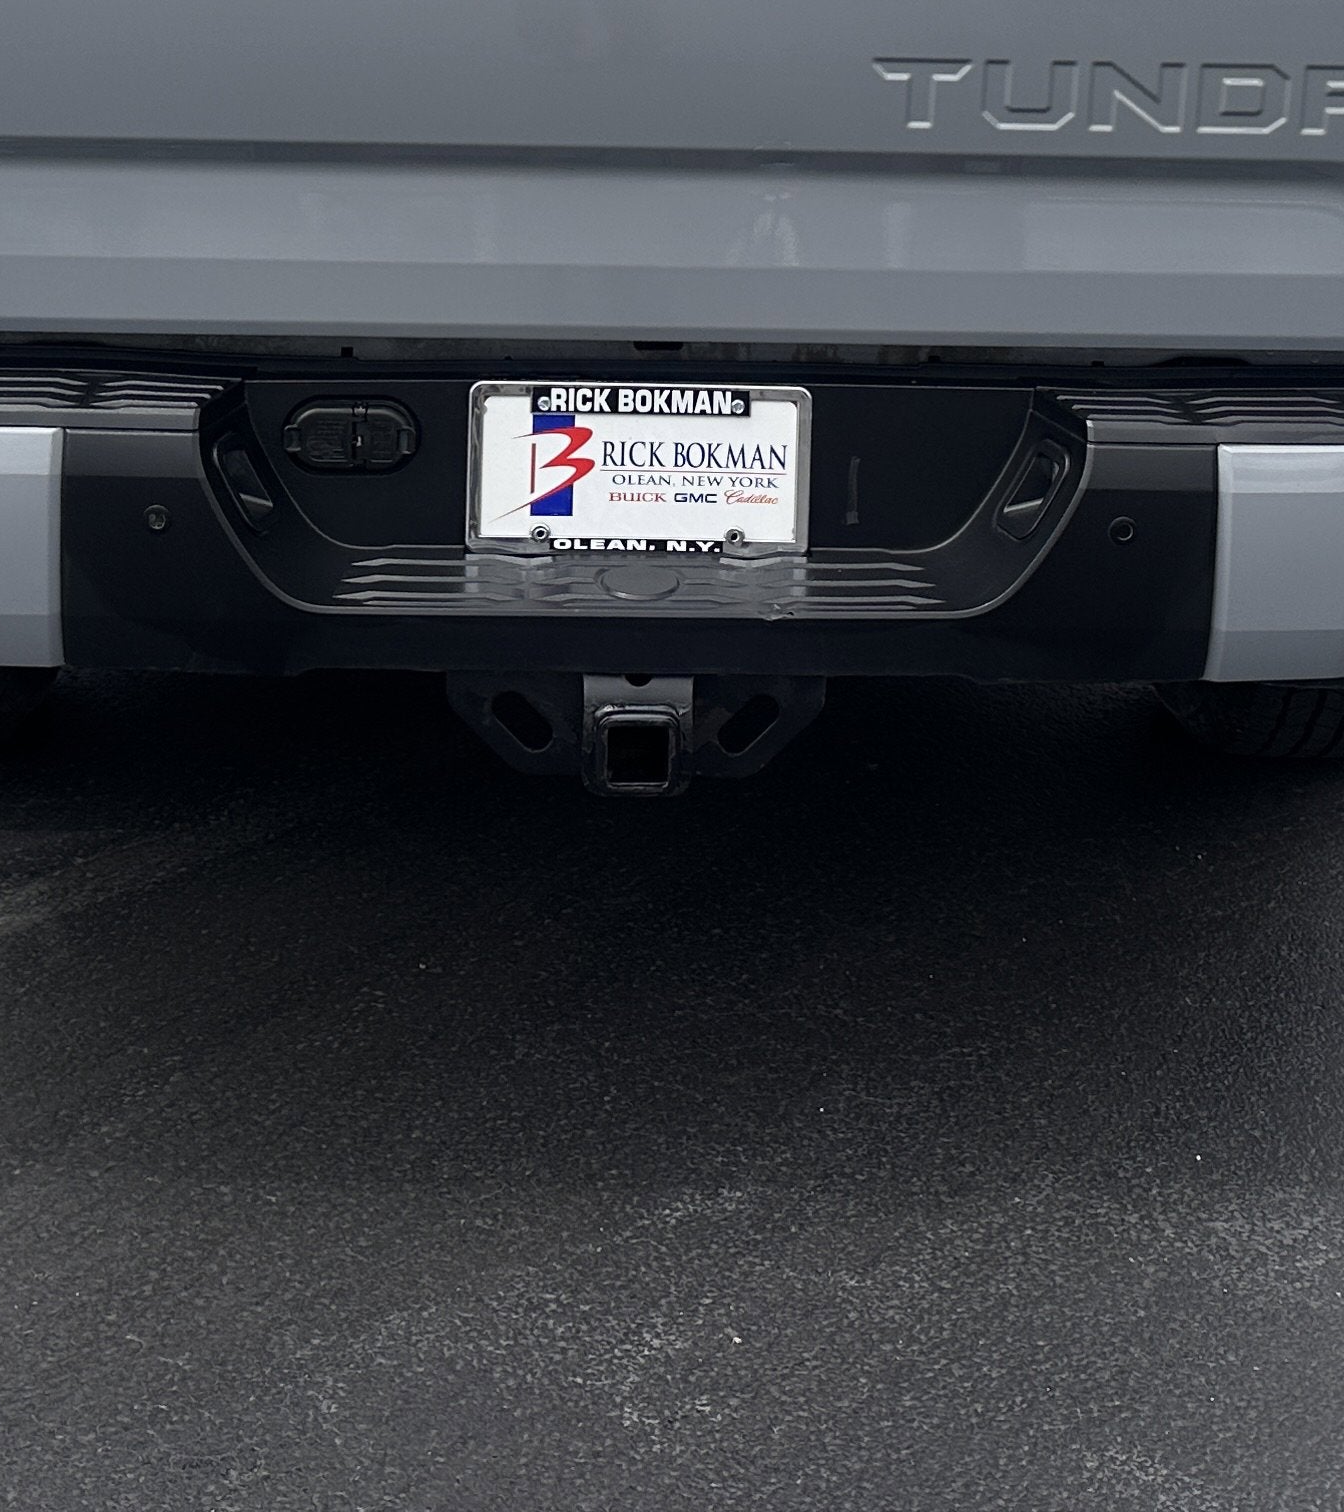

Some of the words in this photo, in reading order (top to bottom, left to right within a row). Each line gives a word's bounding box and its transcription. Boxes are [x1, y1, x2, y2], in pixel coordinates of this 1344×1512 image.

[550, 388, 611, 413] RICK
[618, 389, 733, 415] BOKMAN
[601, 441, 665, 469] RICK
[672, 442, 788, 470] BOKMAN
[612, 474, 676, 487] OLEAN,
[682, 475, 724, 488] NEW
[727, 476, 779, 489] YORK
[608, 492, 667, 504] BUICK
[674, 493, 718, 504] GMC
[723, 490, 779, 506] Cadillac
[553, 538, 656, 552] OLEAN,
[666, 541, 721, 553] N.Y.
